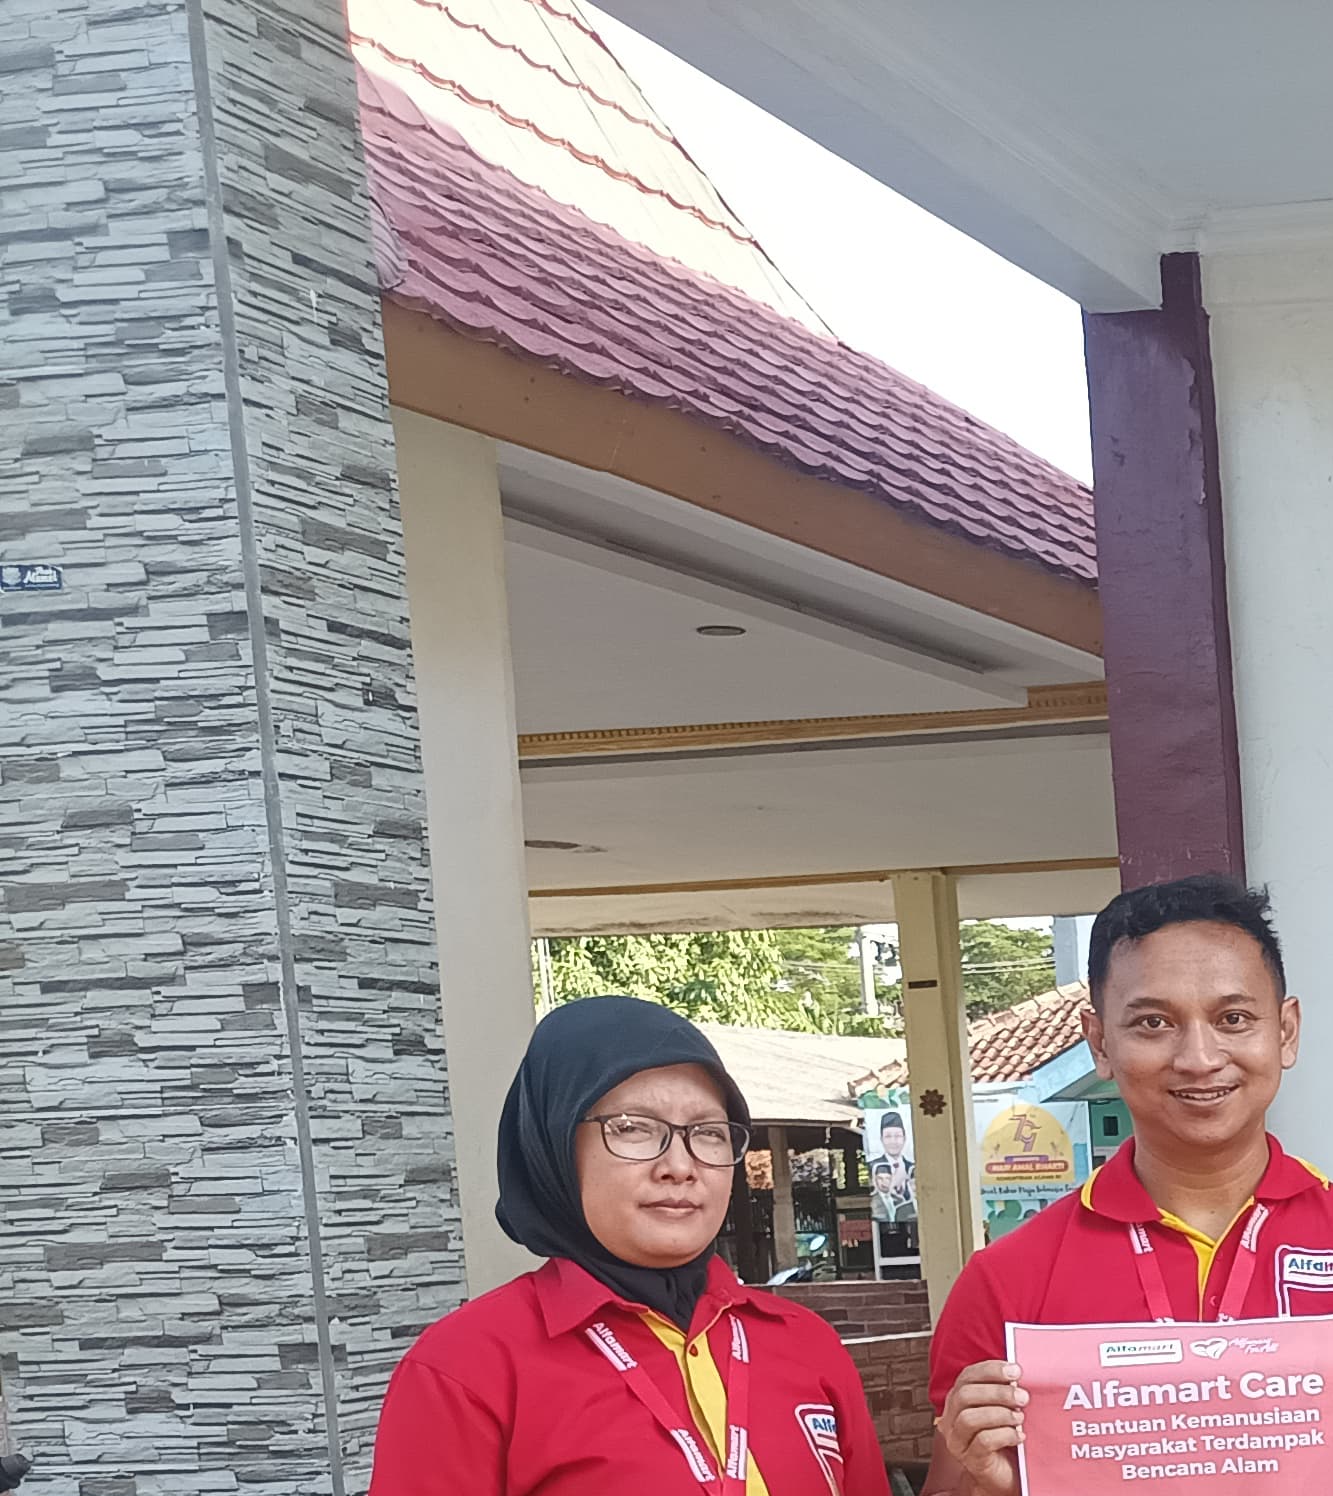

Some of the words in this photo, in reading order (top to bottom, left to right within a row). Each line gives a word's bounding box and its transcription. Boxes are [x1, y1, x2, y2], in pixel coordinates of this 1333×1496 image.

[592, 1321, 639, 1370] Alfamart
[1105, 1342, 1174, 1354] Alfamart
[1063, 1375, 1232, 1410] Alfamart
[1239, 1372, 1324, 1399] Care
[1071, 1416, 1166, 1437] Bantuan
[1171, 1407, 1320, 1430] Kemanusiaan
[678, 1428, 716, 1482] Alfamart
[725, 1424, 741, 1479] Alfamart
[1071, 1437, 1197, 1461] Masyarakat
[1200, 1429, 1324, 1453] Terdampak
[1121, 1460, 1216, 1480] Bencana
[1220, 1456, 1279, 1475] Alam
